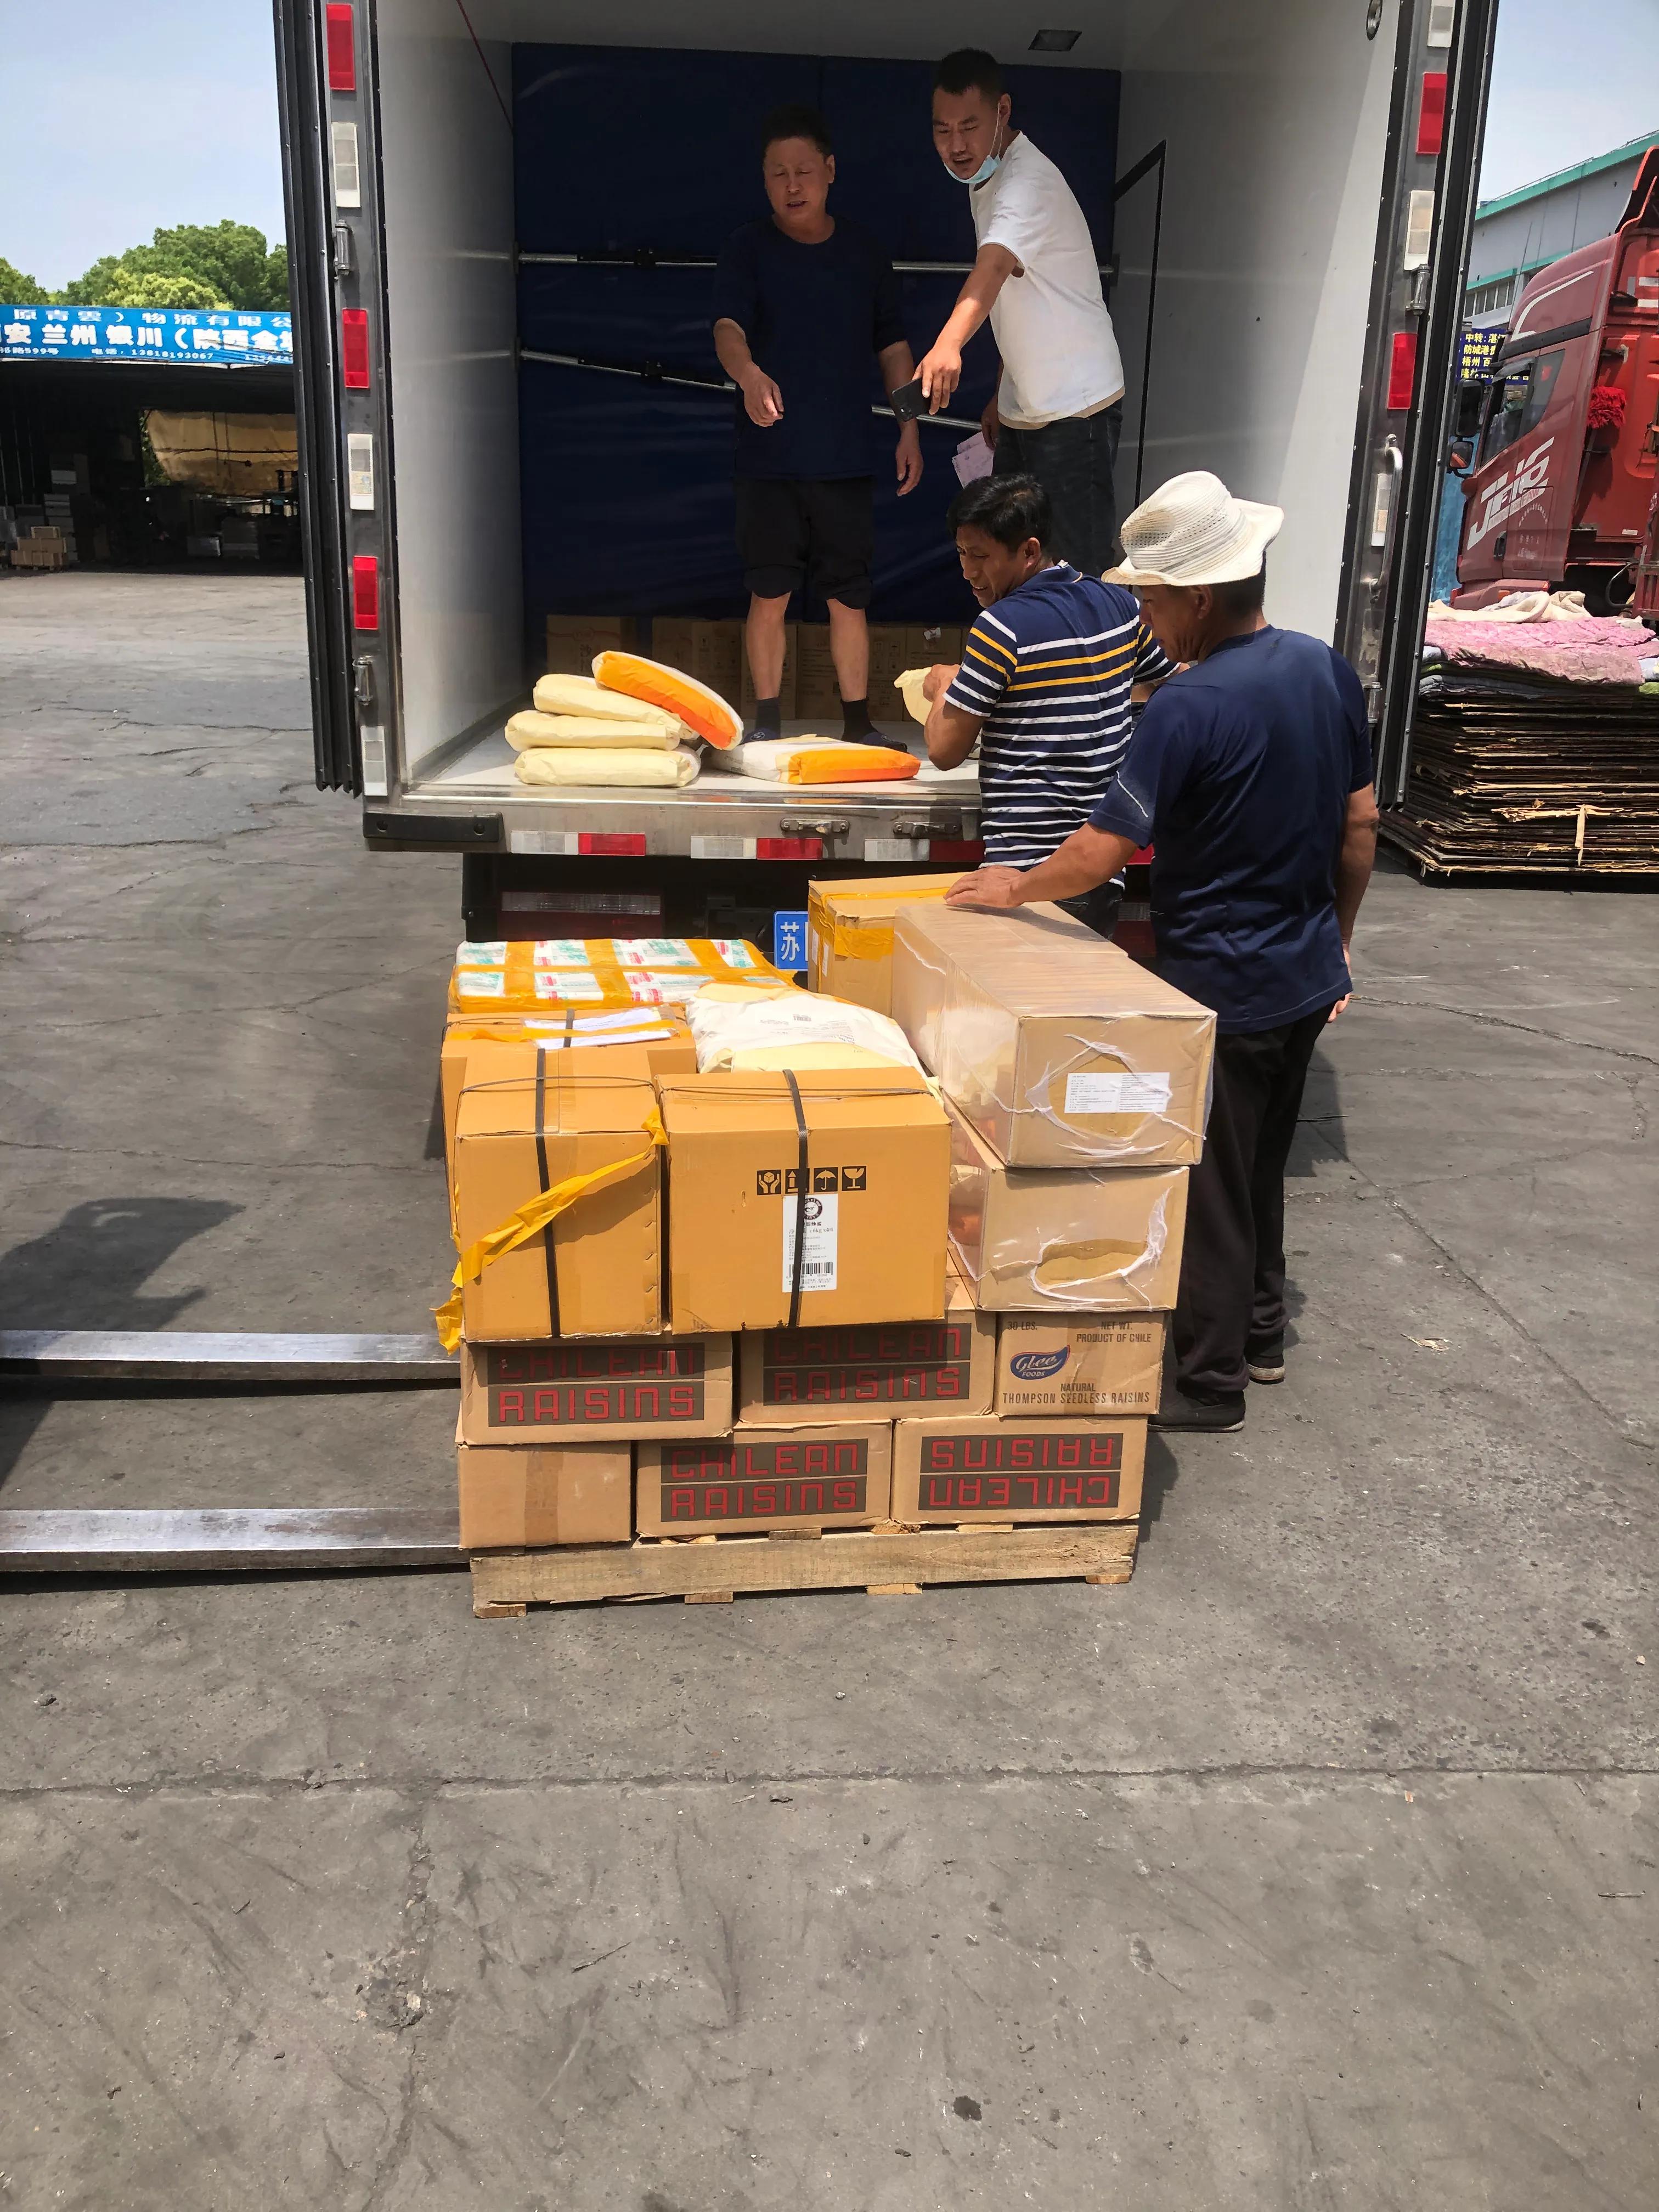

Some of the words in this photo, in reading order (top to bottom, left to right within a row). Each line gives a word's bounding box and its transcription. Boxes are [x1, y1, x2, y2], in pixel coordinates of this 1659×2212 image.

[0, 323, 31, 344] 安
[42, 324, 97, 346] 兰州
[780, 922, 808, 961] 苏
[1007, 1321, 1018, 1330] 30
[1021, 1321, 1037, 1330] LBS.
[1076, 1333, 1114, 1342] PRODUCT
[1116, 1333, 1127, 1342] OF
[1129, 1333, 1152, 1342] CHILE
[1101, 1321, 1115, 1330] NET
[1119, 1321, 1133, 1330] WT.
[1015, 1355, 1063, 1372] Glee
[774, 1367, 961, 1402] RAISINS
[1002, 1393, 1056, 1404] THOMPSON
[1060, 1392, 1107, 1404] SEEDLESS
[1110, 1391, 1150, 1403] RAISINS
[1060, 1383, 1096, 1392] NATURAL
[499, 1387, 693, 1422] RAISINS
[671, 1443, 858, 1479] CHILEAN
[930, 1437, 1114, 1469] RAISINS
[671, 1482, 856, 1516] RAISINS
[928, 1476, 1111, 1506] CHILEAN
